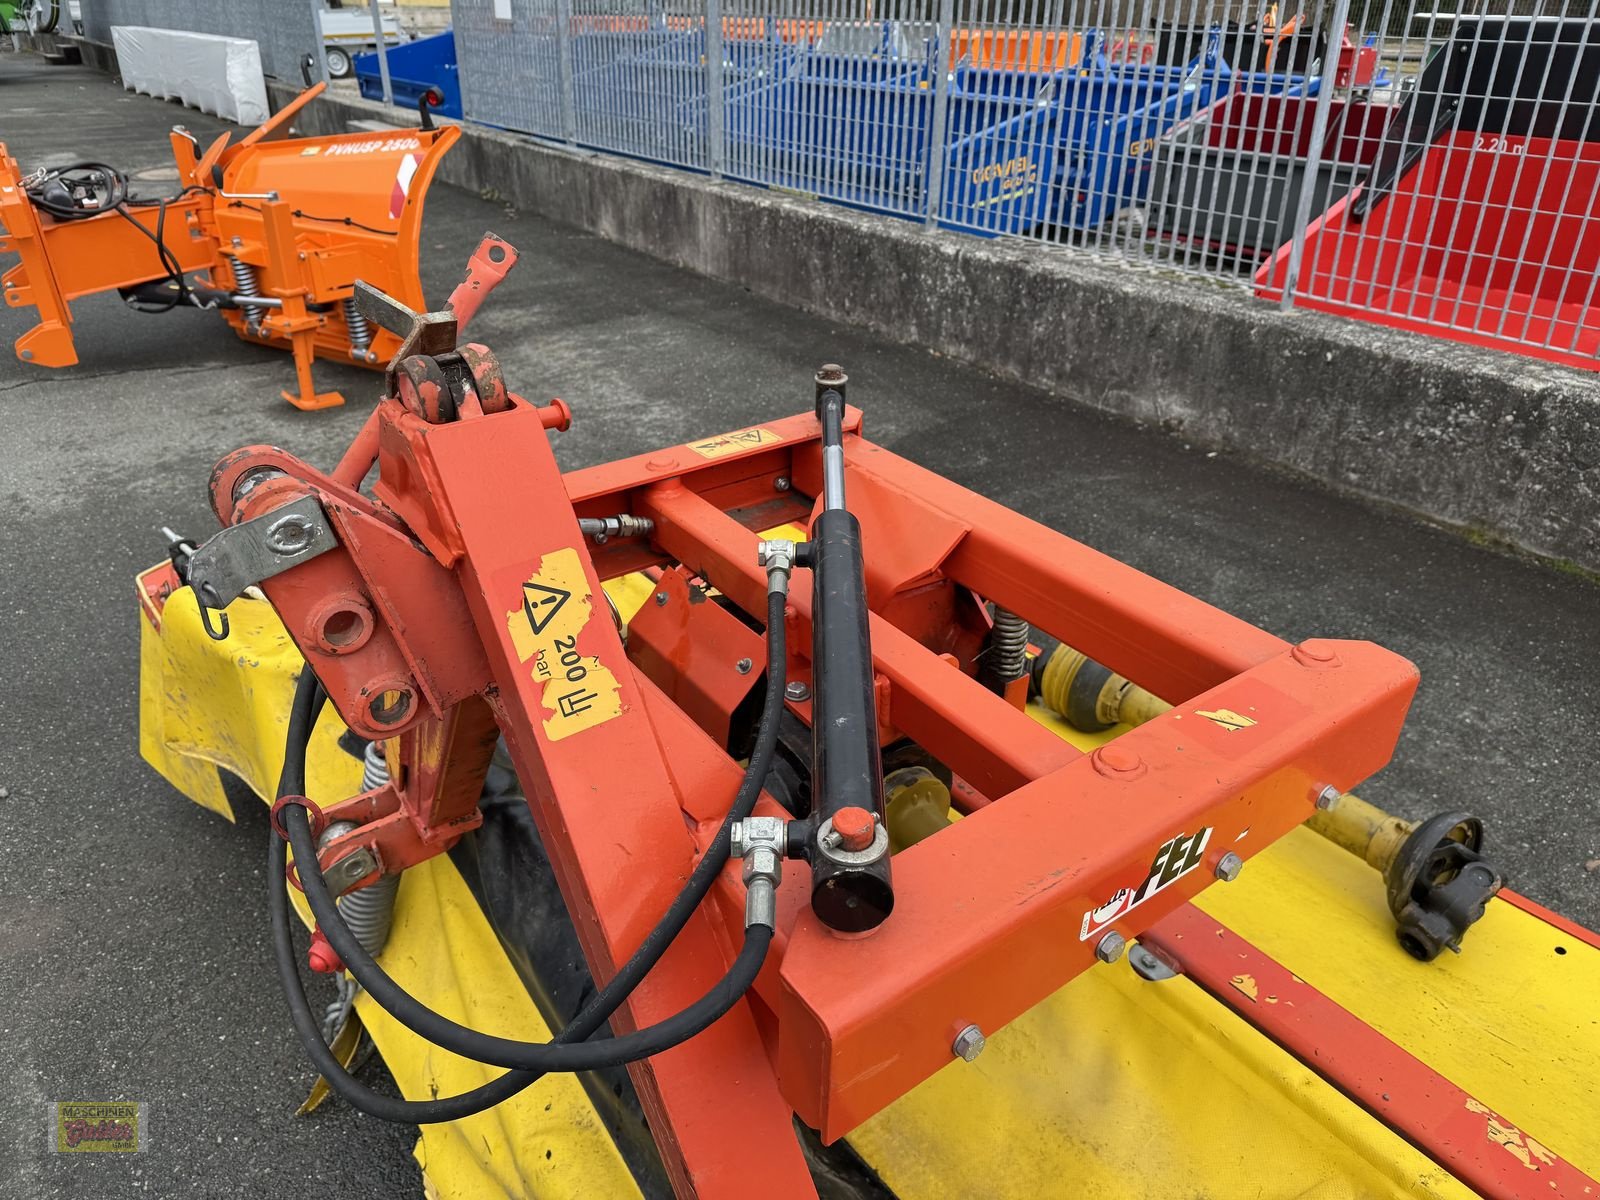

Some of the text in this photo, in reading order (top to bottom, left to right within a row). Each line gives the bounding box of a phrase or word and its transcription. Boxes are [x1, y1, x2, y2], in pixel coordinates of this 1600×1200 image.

[1476, 137, 1508, 153] 2.20
[536, 649, 552, 677] bar
[554, 634, 587, 682] 200
